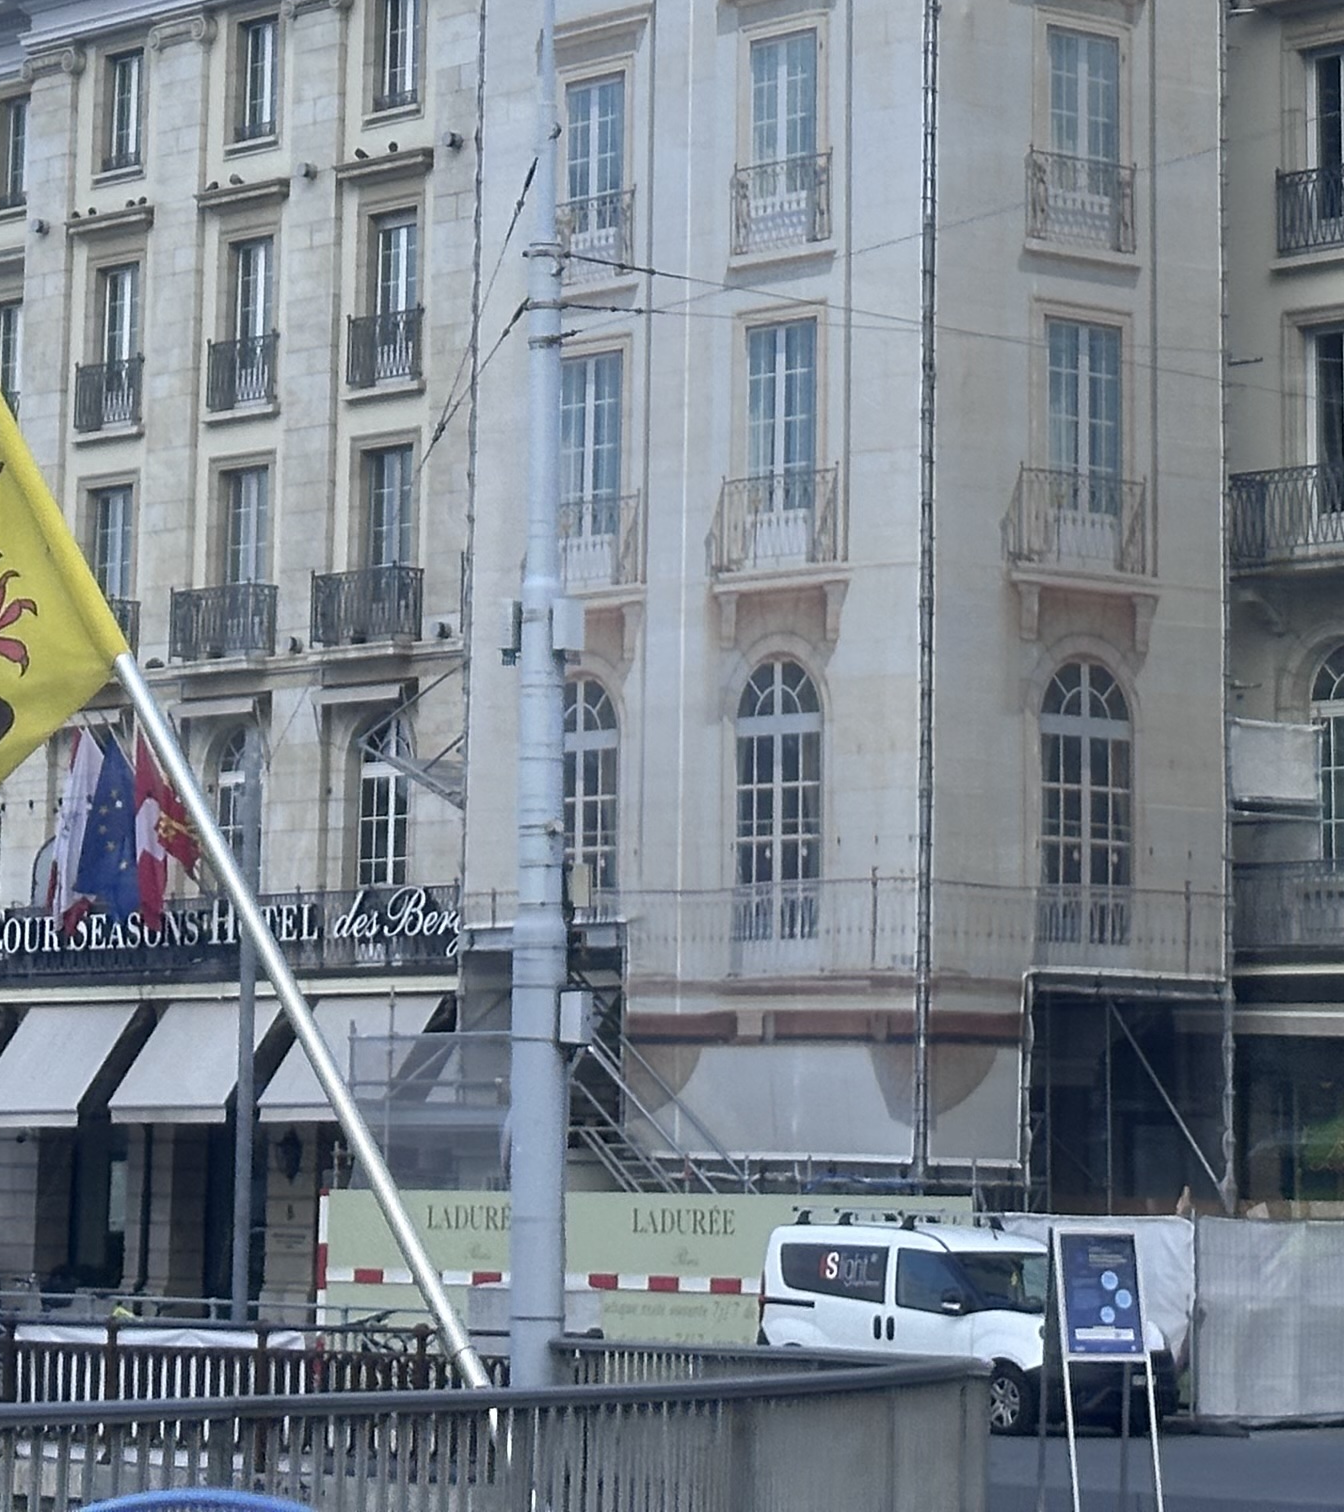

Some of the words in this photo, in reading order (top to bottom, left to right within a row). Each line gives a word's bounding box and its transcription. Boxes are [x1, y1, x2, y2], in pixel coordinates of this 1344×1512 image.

[208, 897, 318, 945] HTEL
[333, 890, 381, 938] des
[426, 1202, 512, 1231] LADURÉ
[632, 1204, 736, 1236] LADURÉE
